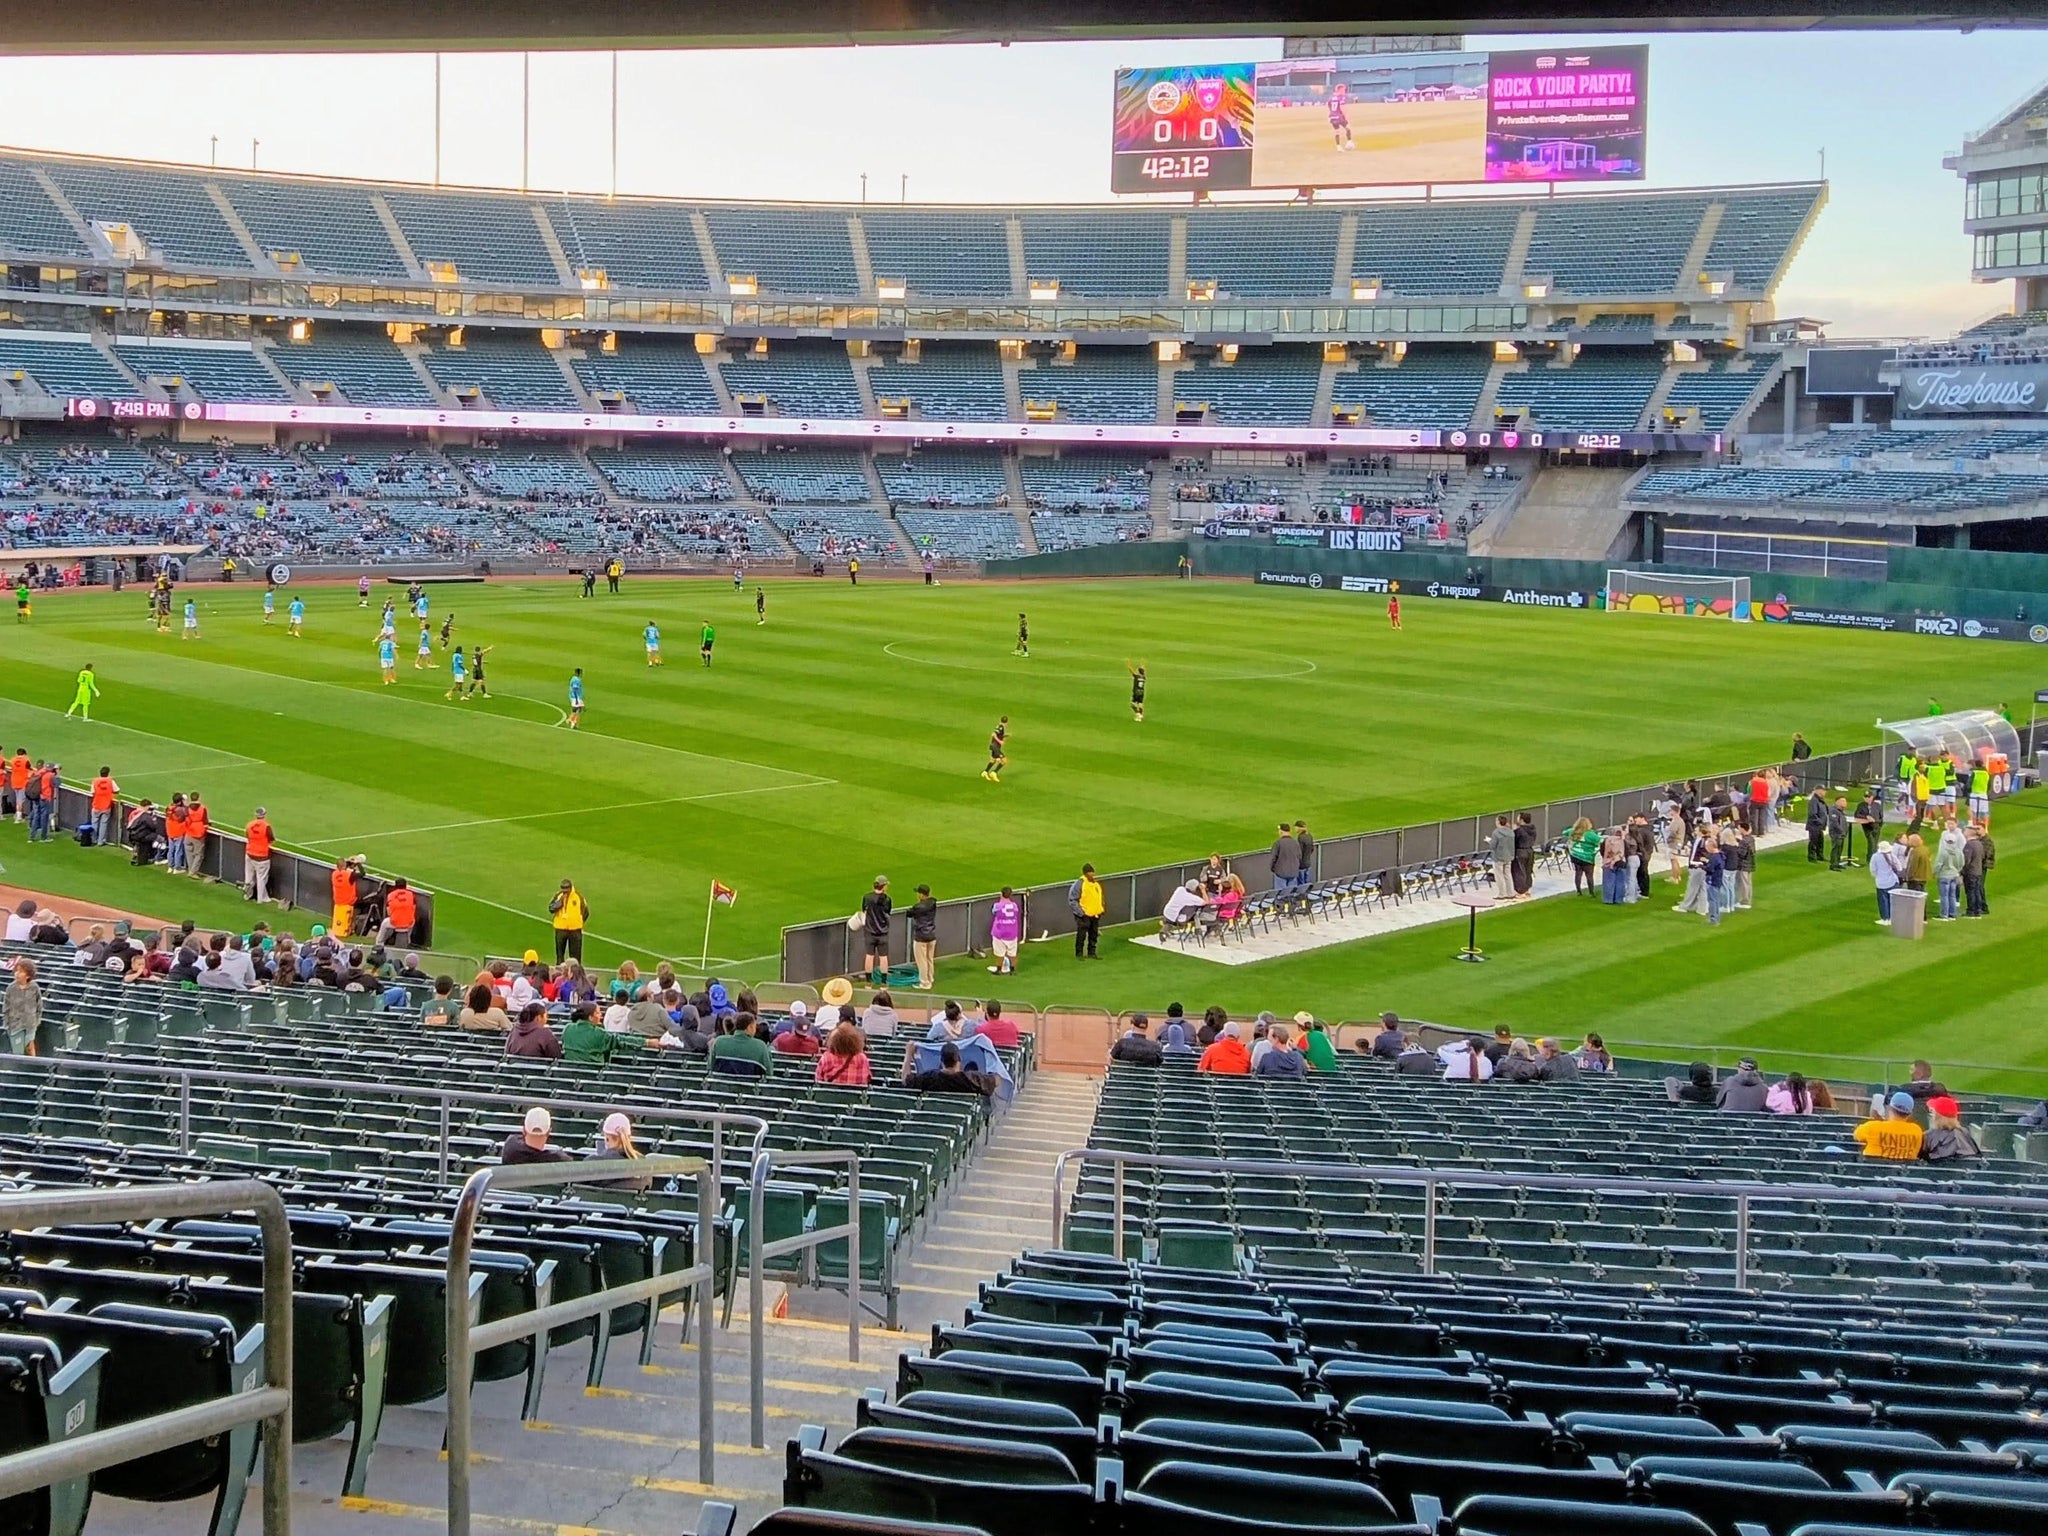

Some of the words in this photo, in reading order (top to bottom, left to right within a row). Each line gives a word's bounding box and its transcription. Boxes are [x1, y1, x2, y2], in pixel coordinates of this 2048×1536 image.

[1494, 77, 1533, 97] ROCK
[1536, 75, 1575, 96] YOUR
[1578, 73, 1632, 94] PARTY!
[1154, 119, 1172, 142] 0
[1200, 118, 1217, 141] 0
[1142, 156, 1209, 179] 42:12
[1908, 370, 2036, 411] Treehouse
[111, 401, 144, 416] 7:48
[147, 402, 170, 417] PM
[1479, 433, 1491, 446] 0
[1531, 433, 1543, 447] 0
[1578, 434, 1621, 448] 42:12
[1330, 530, 1354, 550] LOS
[1357, 531, 1402, 551] ROOTS
[1261, 572, 1306, 584] Penumbra
[1440, 585, 1480, 598] THREDUP
[1503, 589, 1565, 607] Anthem
[1915, 618, 1941, 635] FOX
[1880, 1132, 1917, 1149] KNOW
[69, 1404, 81, 1430] 30
